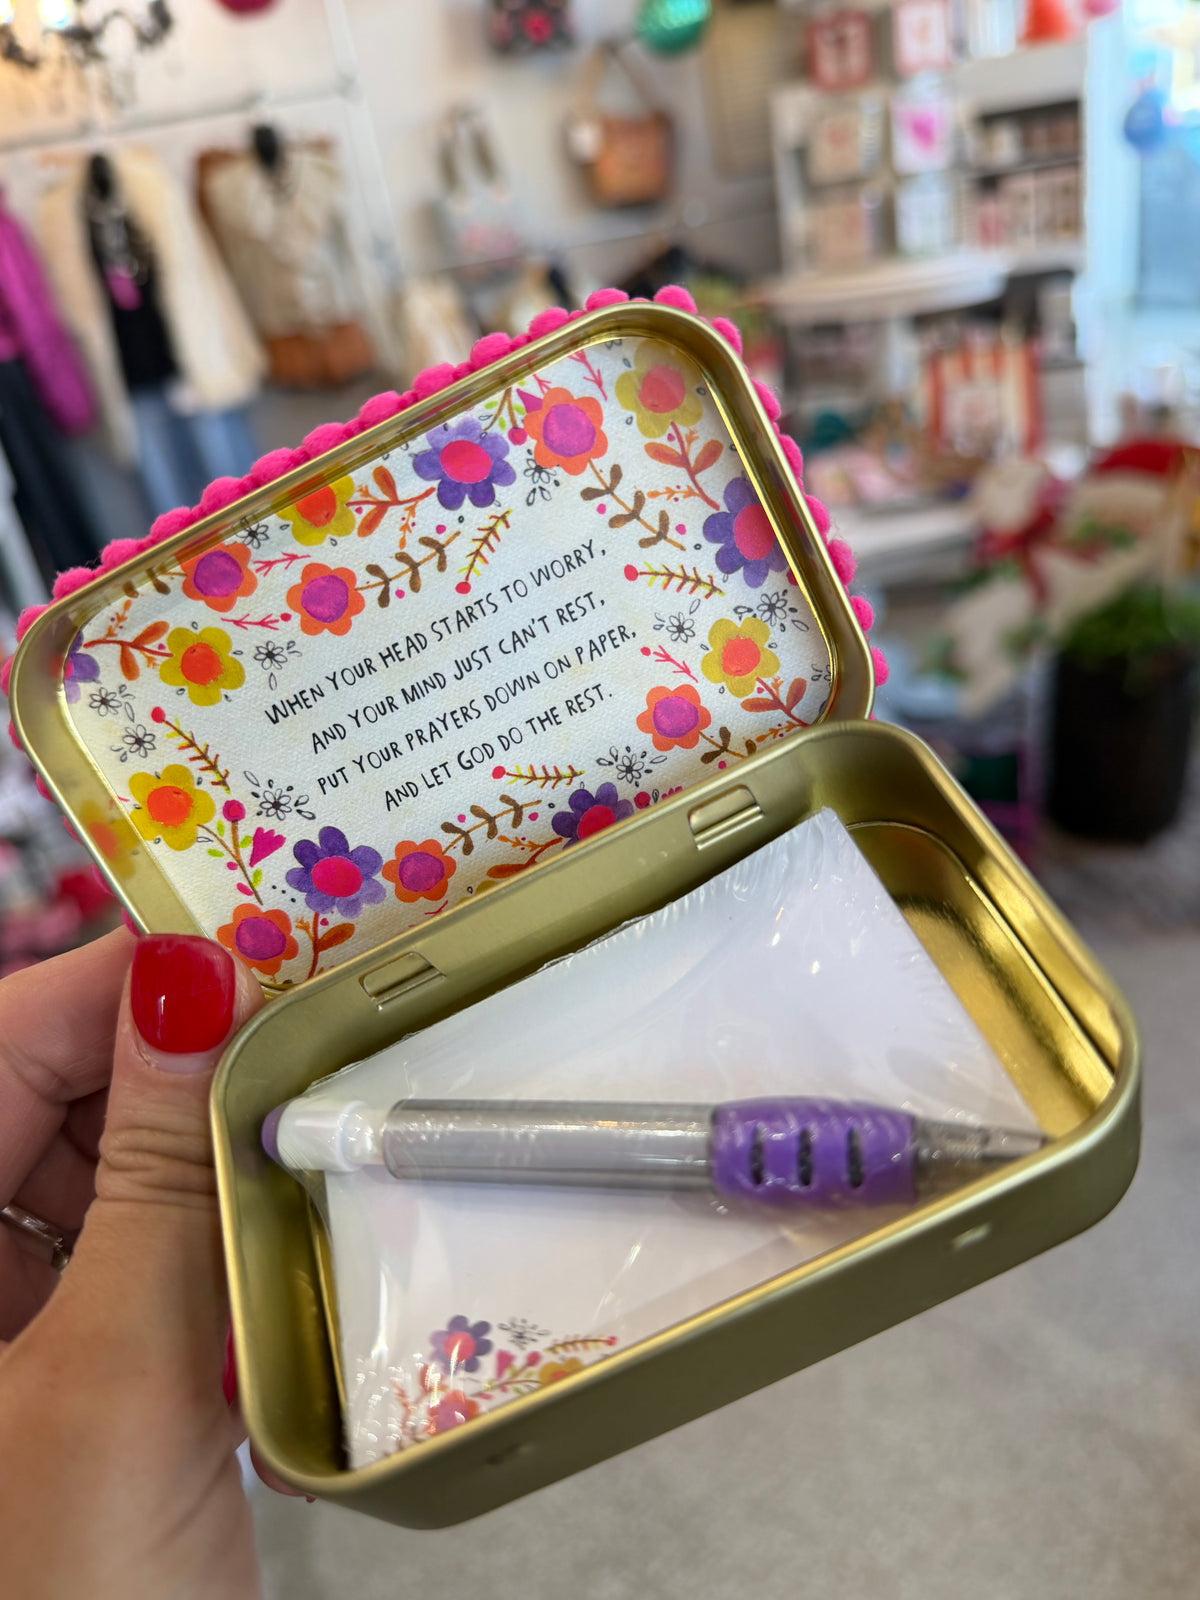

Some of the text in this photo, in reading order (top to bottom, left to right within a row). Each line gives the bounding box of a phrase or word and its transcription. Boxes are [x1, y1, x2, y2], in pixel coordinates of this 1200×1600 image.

[264, 539, 606, 725] WHEN YOUR HEAD STARTS TO WORRY,
[312, 591, 605, 754] AND YOUR MIND JUST CAN'T REST,
[317, 624, 637, 795] PUT YOUR PRAYERS DOWN ON PAPER,
[385, 683, 612, 812] AND LET GOD DO THE REST.
